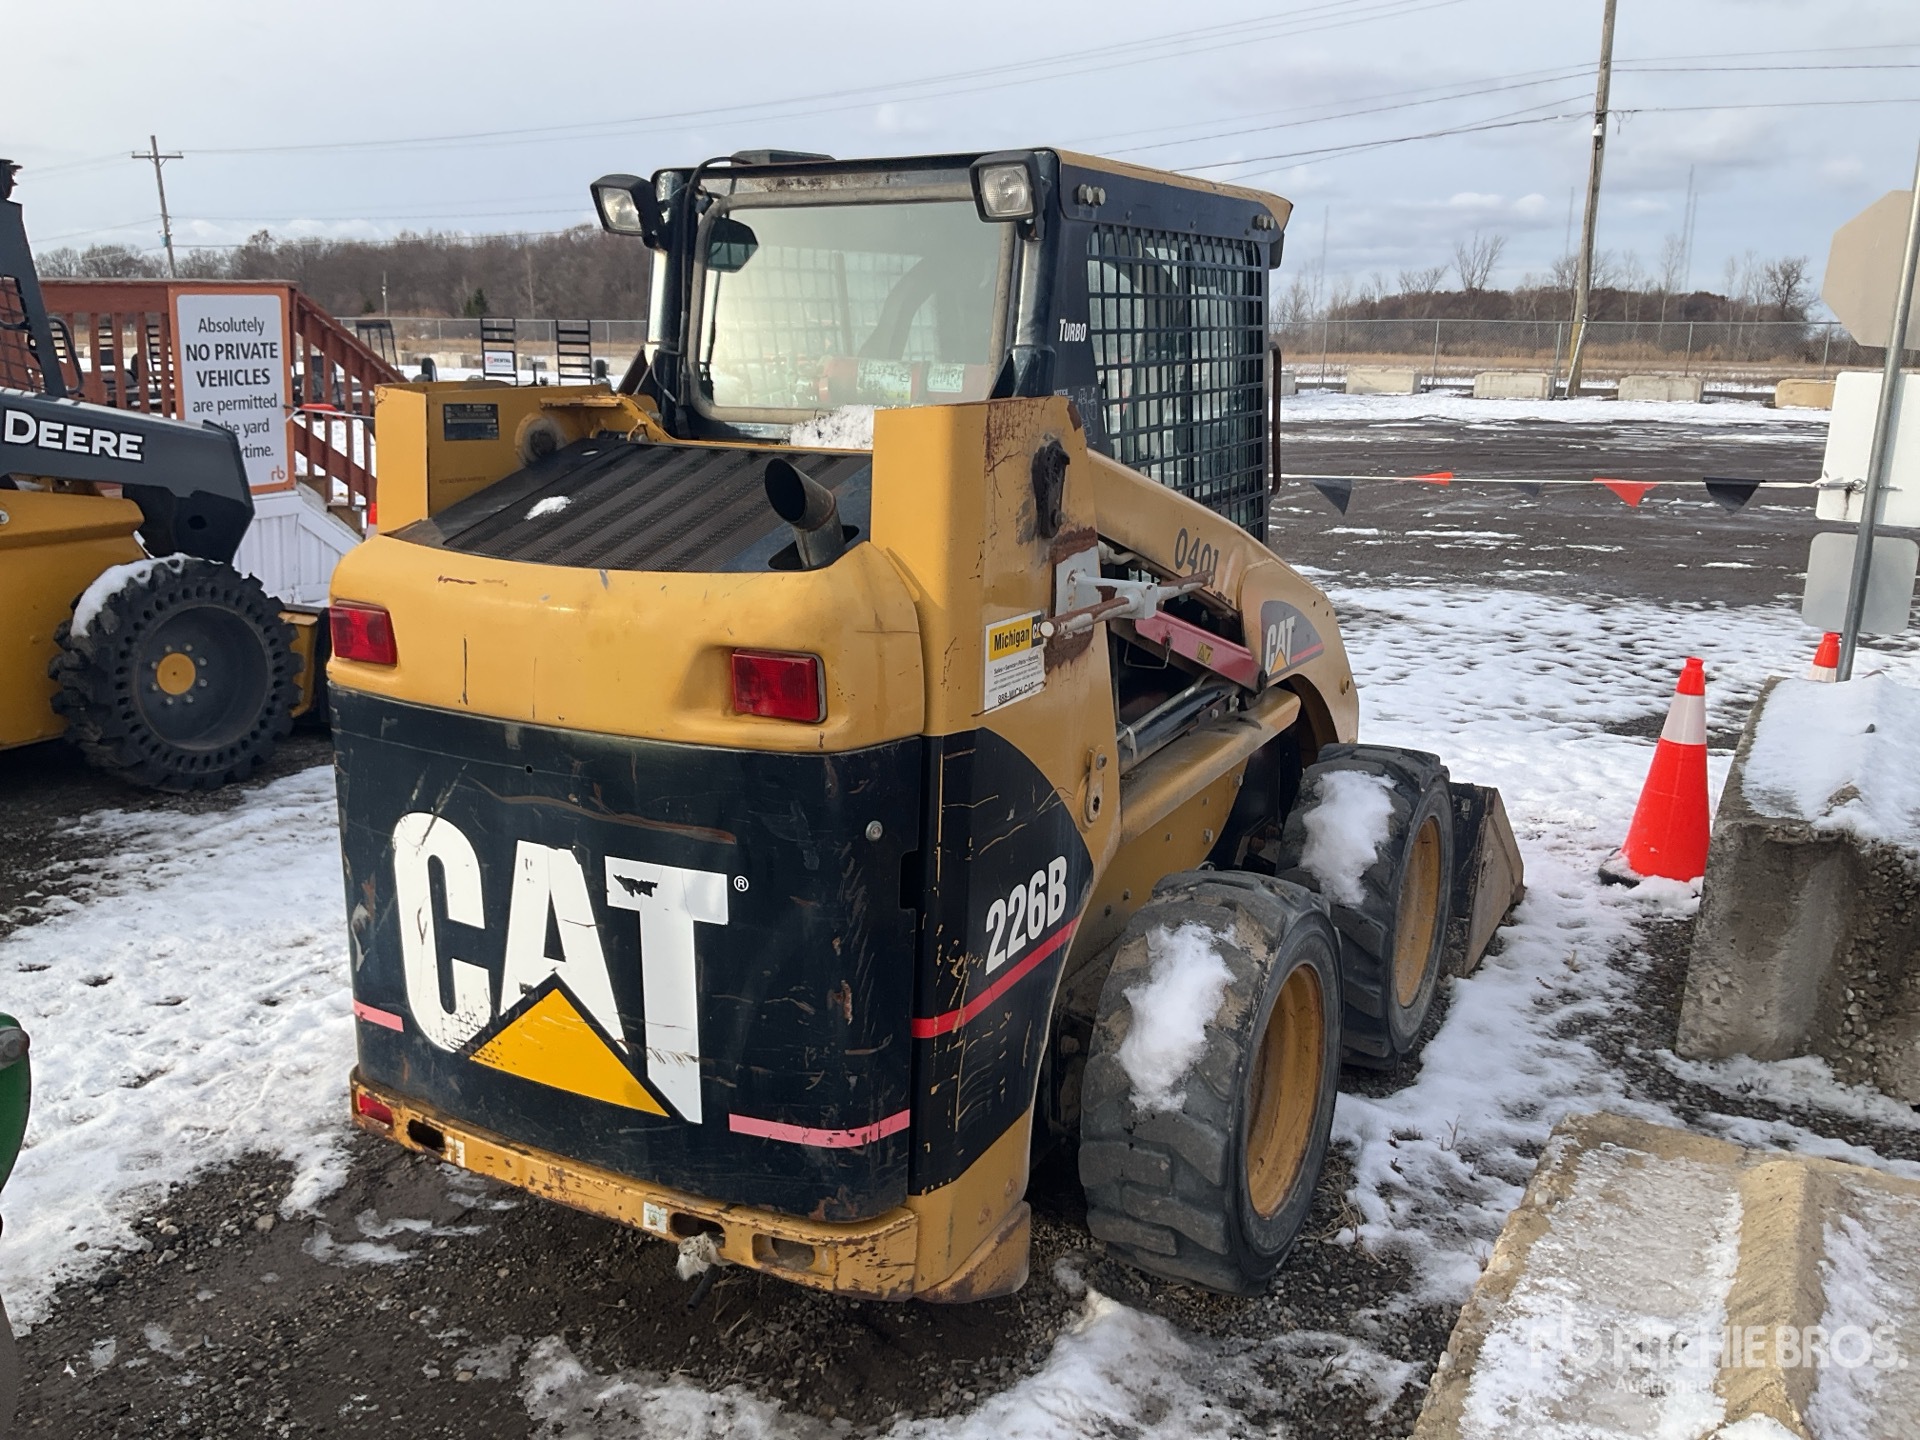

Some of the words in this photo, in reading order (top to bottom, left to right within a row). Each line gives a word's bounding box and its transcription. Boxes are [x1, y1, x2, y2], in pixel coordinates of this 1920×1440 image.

[198, 316, 265, 336] Absolutely
[185, 344, 211, 362] NO
[215, 341, 279, 361] PRIVATE
[196, 368, 271, 388] VEHICLES
[193, 399, 214, 413] are
[217, 393, 278, 415] permitted
[3, 409, 144, 461] DEERE
[243, 417, 270, 438] yard
[993, 628, 1030, 652] Michigan
[1265, 615, 1298, 677] CAT
[985, 855, 1068, 977] 226B
[392, 811, 729, 1125] CAT
